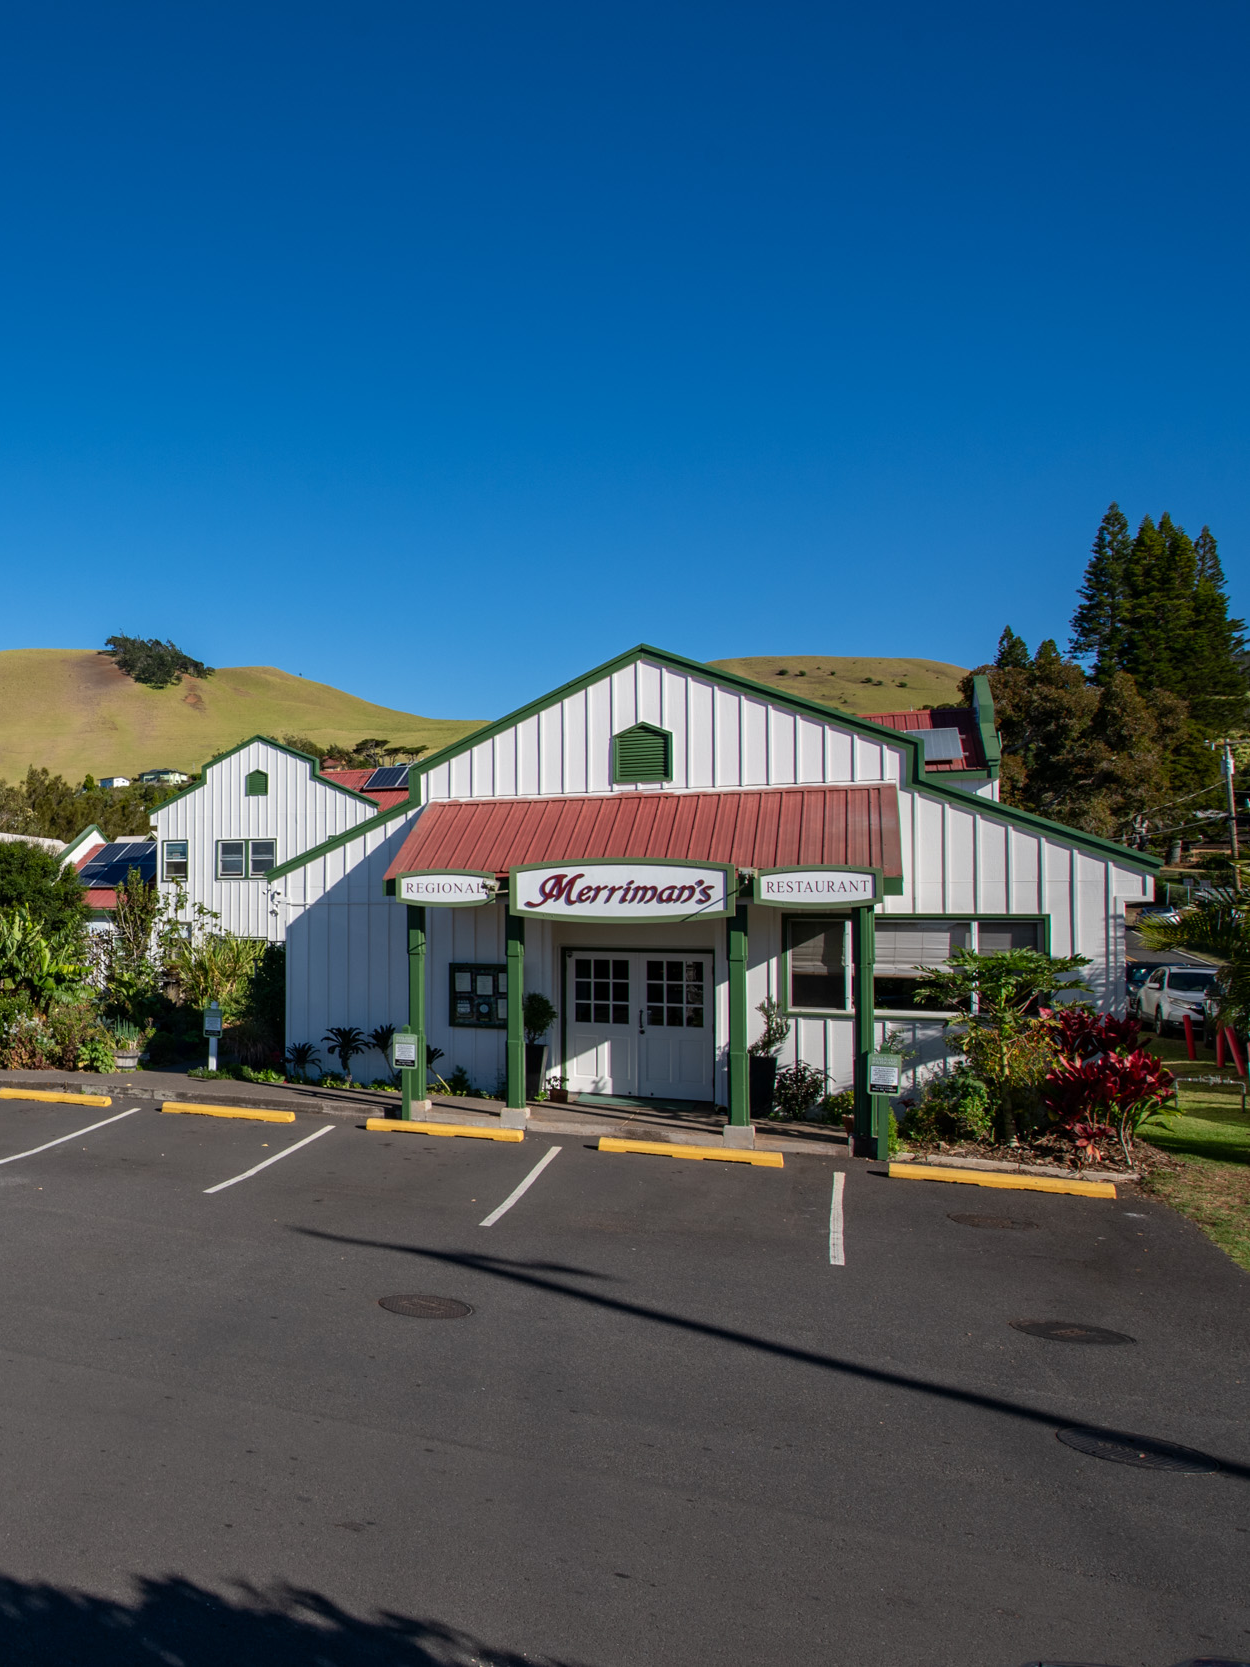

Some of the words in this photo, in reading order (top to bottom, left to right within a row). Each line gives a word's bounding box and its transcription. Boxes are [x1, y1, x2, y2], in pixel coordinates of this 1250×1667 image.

[406, 882, 485, 894] REGIONAL
[524, 873, 715, 908] Merriman's
[766, 880, 869, 893] RESTAURANT
